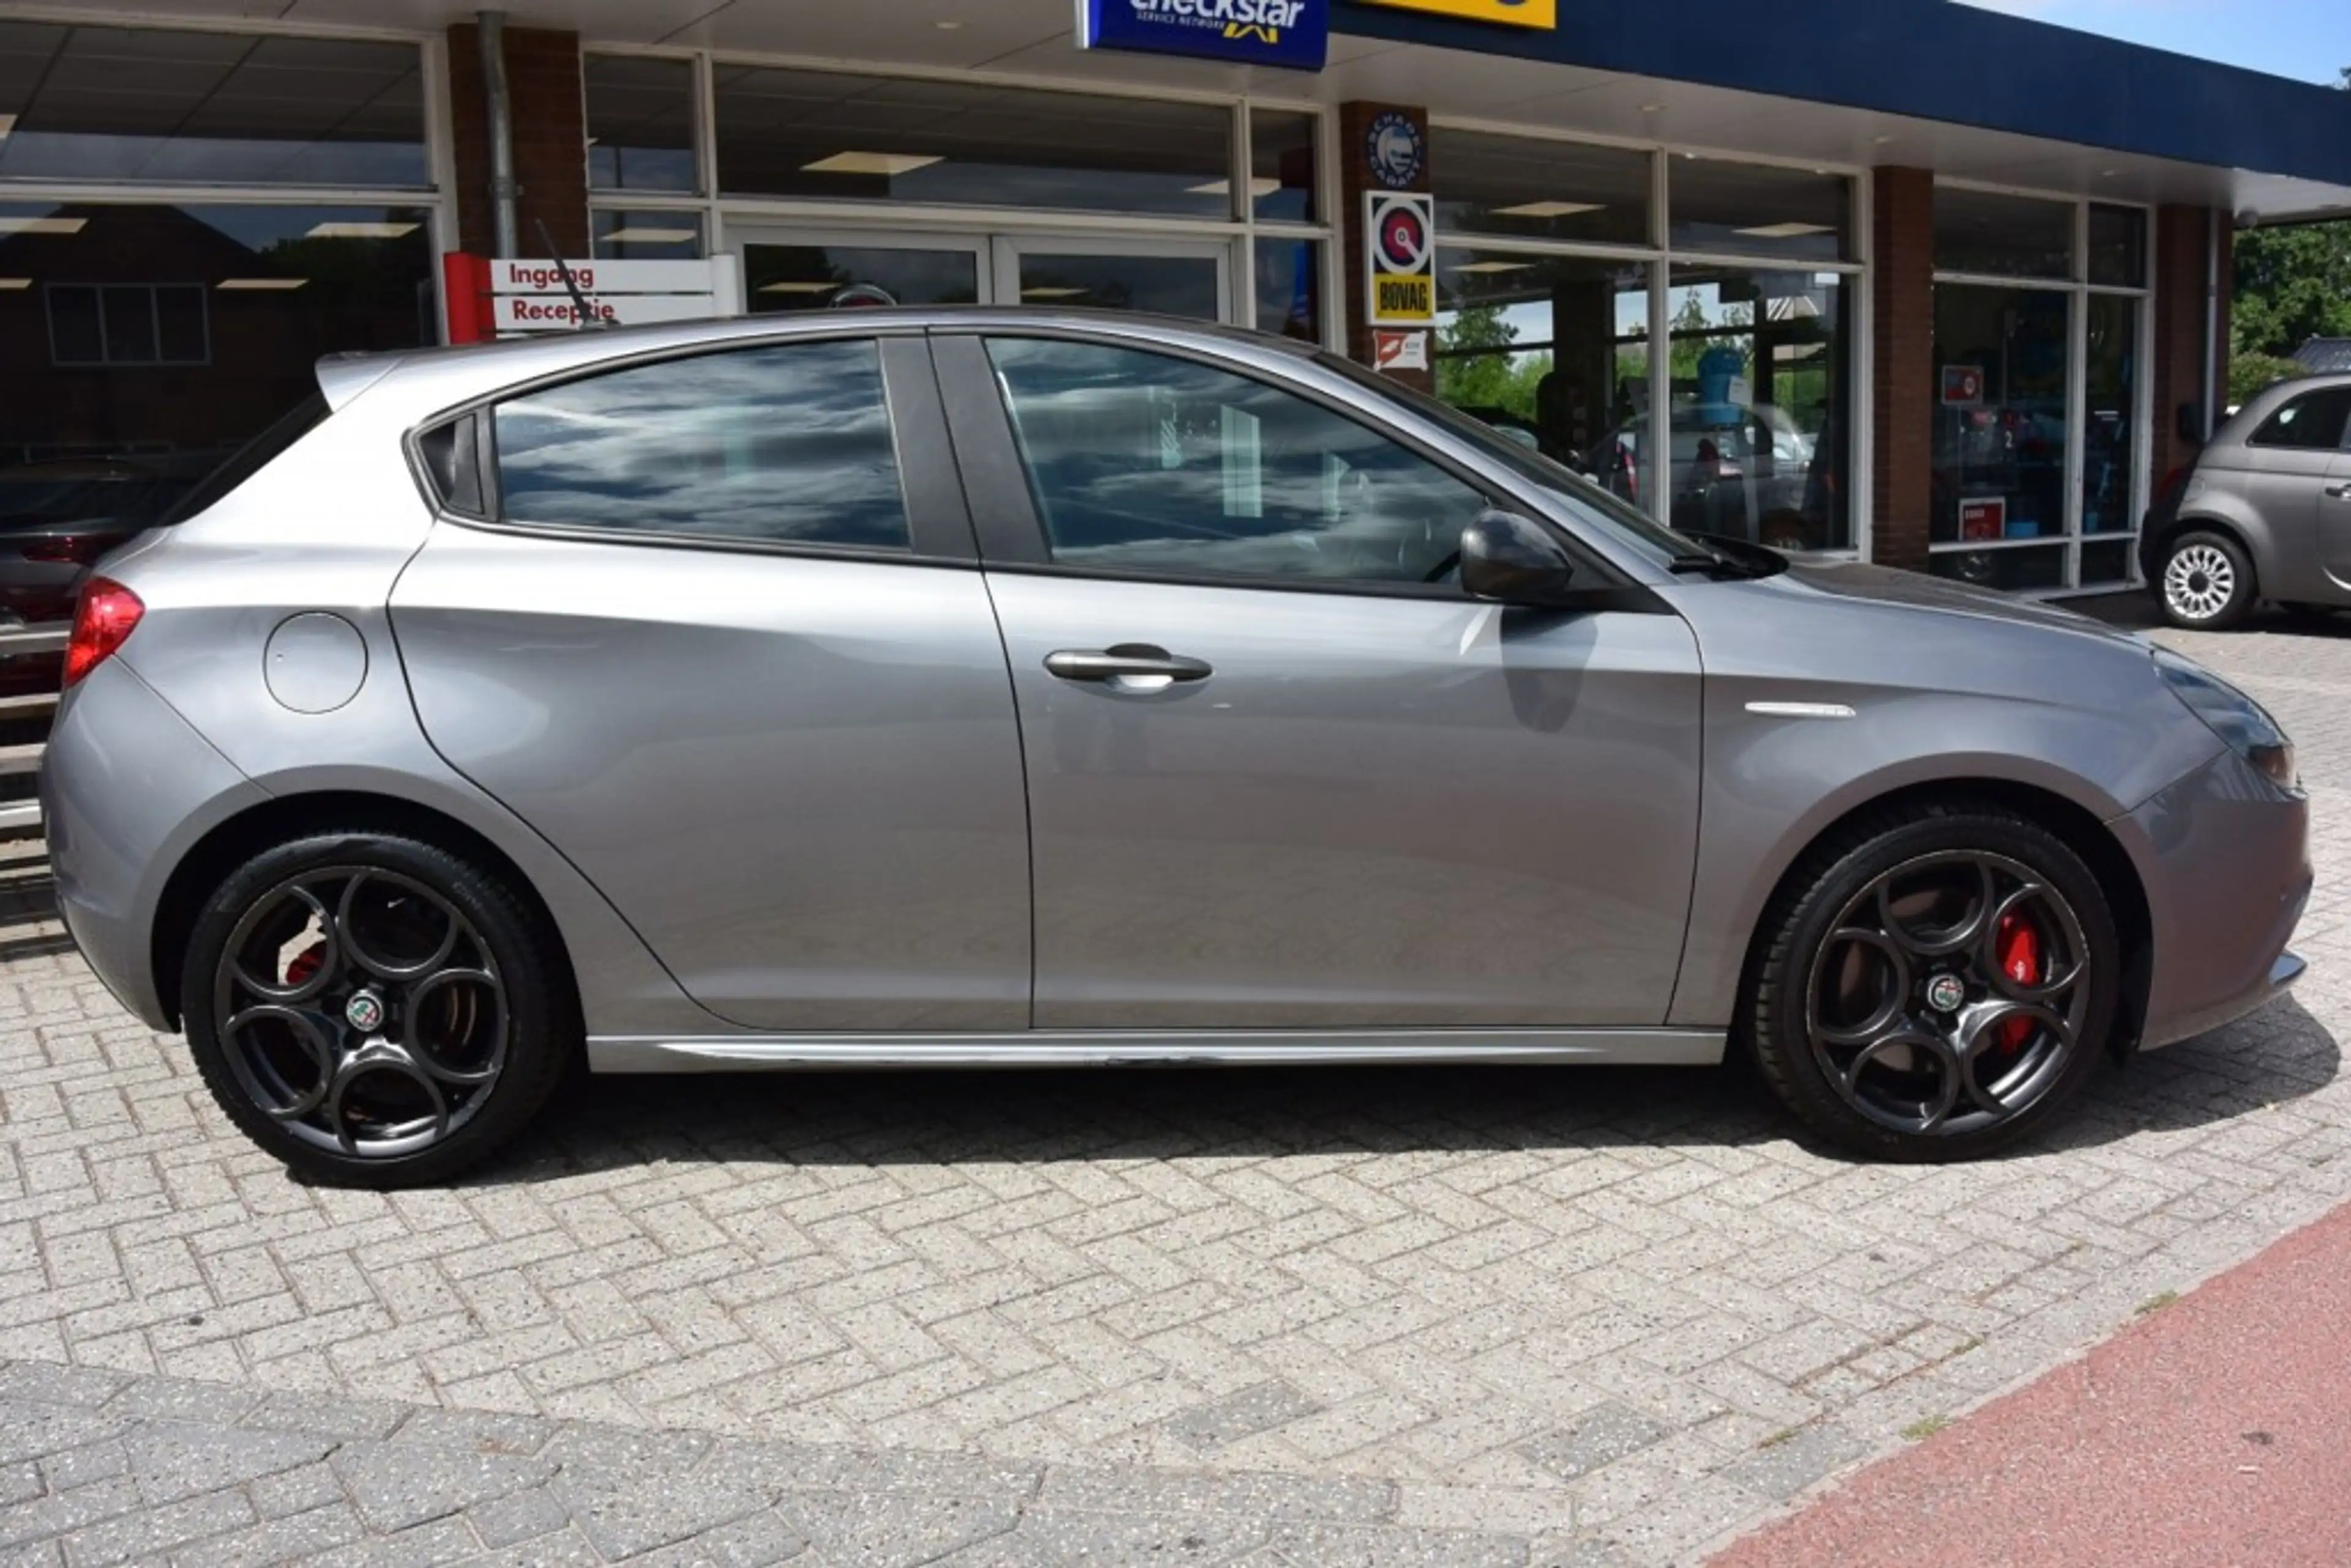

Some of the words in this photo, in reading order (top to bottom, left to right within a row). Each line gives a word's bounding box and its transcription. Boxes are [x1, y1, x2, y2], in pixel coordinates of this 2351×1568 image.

[1136, 11, 1176, 24] SERVICE
[1178, 15, 1225, 29] NETWORK
[1379, 282, 1427, 311] BOVAG
